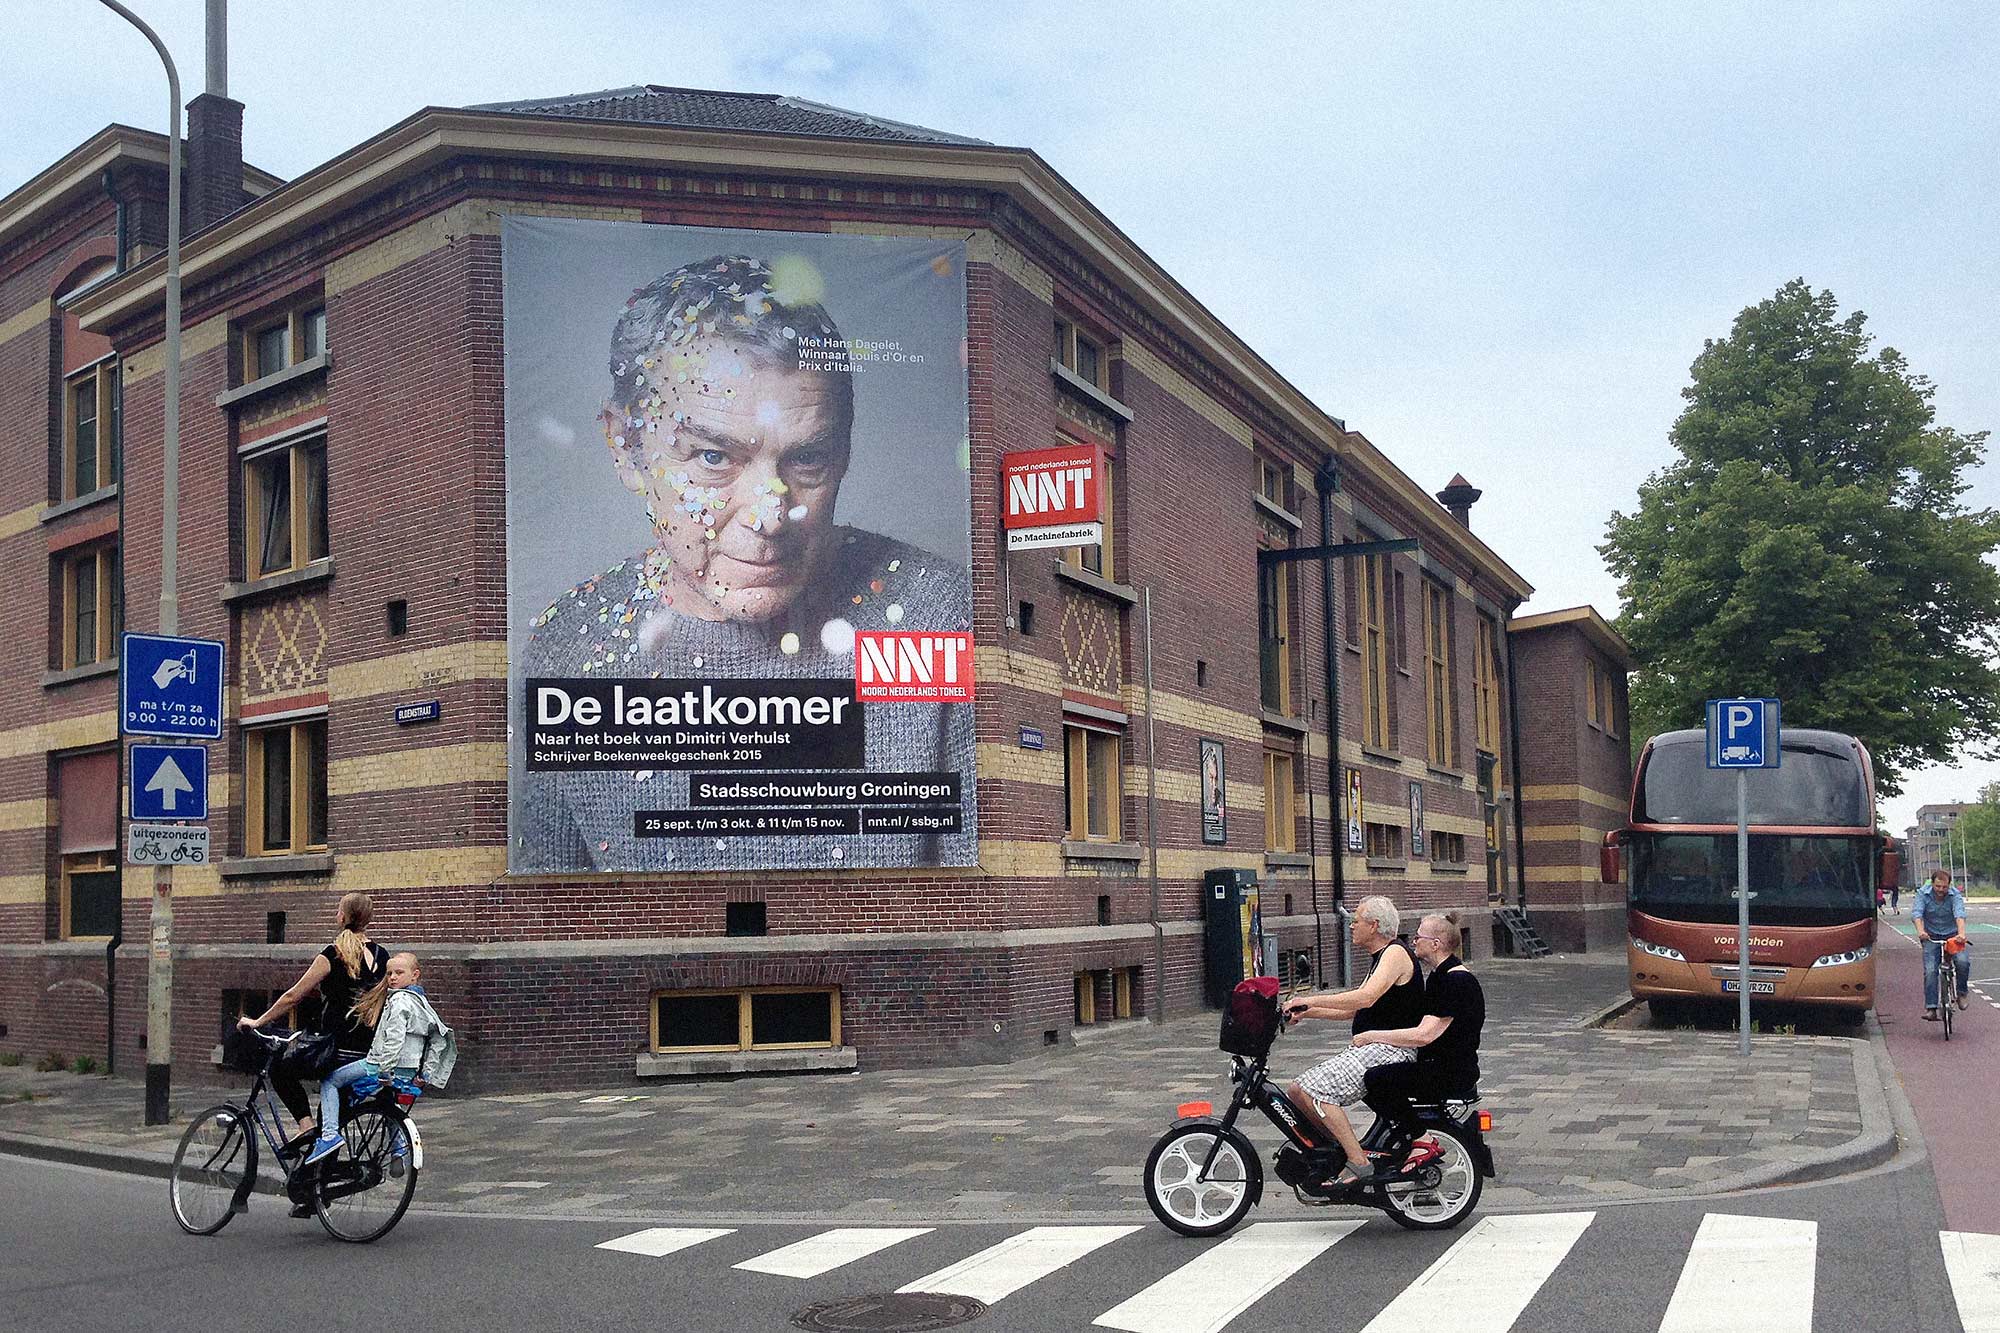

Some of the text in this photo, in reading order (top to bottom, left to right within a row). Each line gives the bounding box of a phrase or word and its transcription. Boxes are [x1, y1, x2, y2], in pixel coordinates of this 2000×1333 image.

[798, 336, 903, 351] Met Hans Dagelet,
[798, 348, 924, 363] Winnaar Louis d'Or en
[798, 360, 867, 373] Prix d'Italia.
[1009, 464, 1030, 472] noord
[1030, 460, 1069, 470] nederlands
[1010, 468, 1092, 516] NNT
[1011, 528, 1094, 544] De Machinefabriek
[860, 637, 967, 683] NNT
[861, 686, 967, 696] NOORD NEDERLANDS TONEEL
[140, 700, 203, 714] ma t/m za
[537, 684, 849, 726] De laatkomer
[128, 712, 156, 724] 9.00
[170, 714, 206, 726] 22.00
[210, 718, 217, 728] h
[1728, 706, 1753, 739] P
[535, 731, 791, 746] Naar het boek van Dimitri Verhulst
[534, 750, 762, 764] Schrijver Boekenweekgeschenk 2015
[700, 782, 951, 800] Stadsschouwburg Groningen
[645, 817, 845, 832] 25 sept. t/m 3 okt. & 11 t/m 15 nov.
[868, 816, 954, 828] nnt.nl / ssbg.nl
[134, 828, 206, 841] uitgezonderd
[1714, 936, 1784, 947] von ahden
[1758, 983, 1773, 992] 276
[1270, 1100, 1297, 1127] TOMOS
